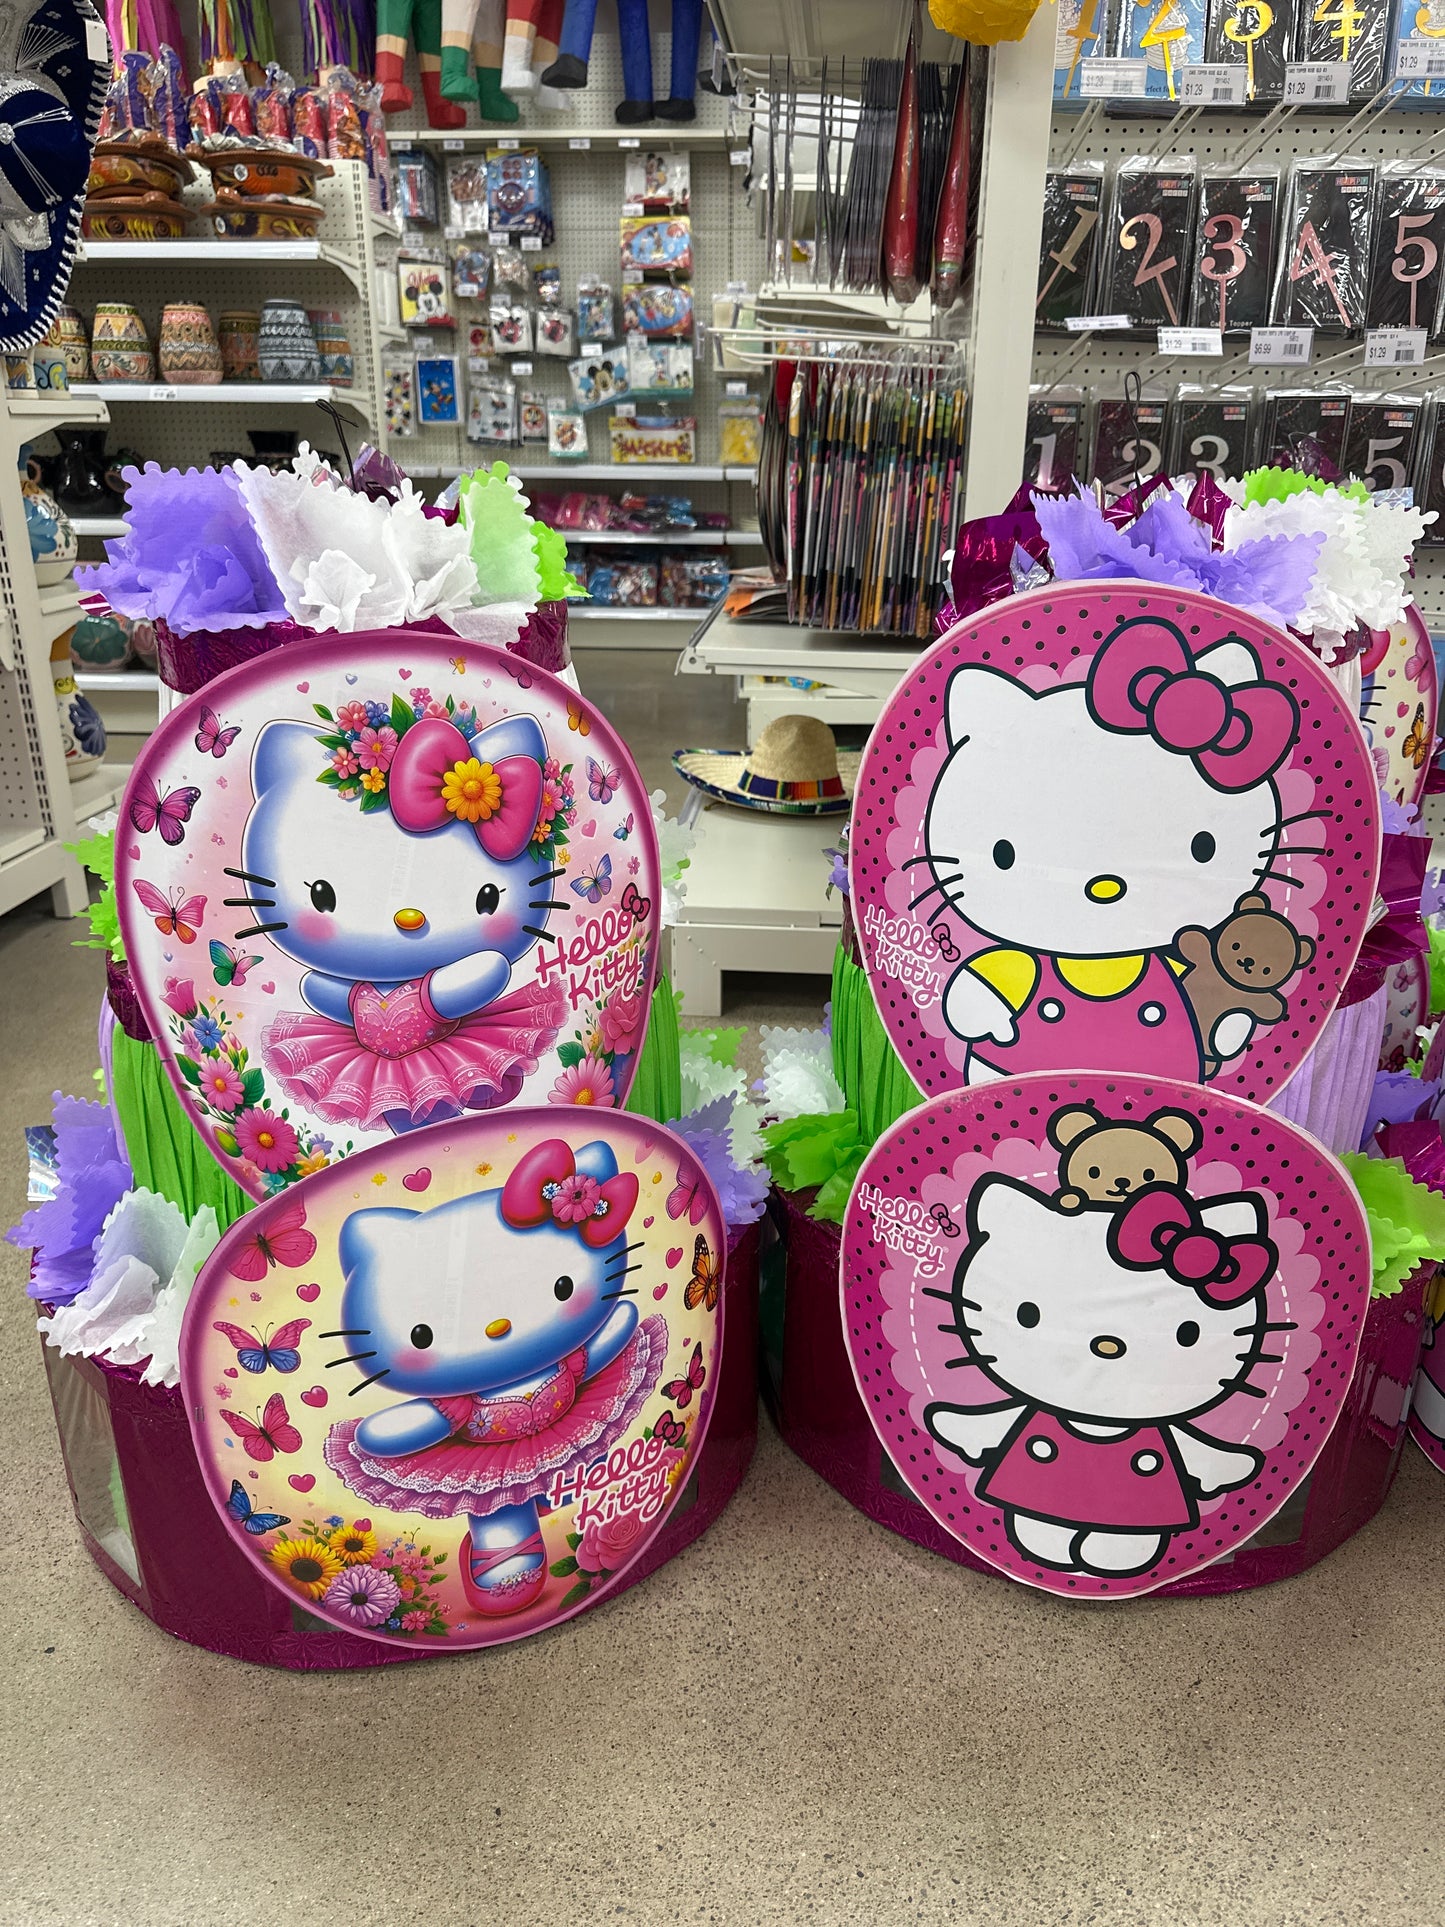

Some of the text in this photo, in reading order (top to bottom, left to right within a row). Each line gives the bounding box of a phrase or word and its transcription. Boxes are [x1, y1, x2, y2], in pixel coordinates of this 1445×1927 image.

[1185, 83, 1203, 95] $1.29
[1287, 82, 1306, 95] $1.29
[1400, 56, 1418, 68] $1.29
[1049, 205, 1099, 273] 1
[1119, 213, 1178, 288] 2
[1201, 213, 1247, 281] 3
[1291, 220, 1351, 286] 4
[1391, 212, 1438, 283] 5
[1254, 343, 1272, 355] $6.99
[1369, 346, 1386, 358] $1.29
[1032, 433, 1059, 492] 1
[1104, 439, 1162, 498] 2
[1186, 435, 1230, 482] 3
[1364, 436, 1406, 493] 5
[534, 909, 634, 985] Hello
[864, 904, 940, 963] Hello
[567, 945, 642, 1012] Kitty
[876, 940, 940, 1009] Kitty
[858, 1182, 940, 1238] Hello
[873, 1215, 945, 1279] Kitty
[549, 1437, 665, 1507] Hello
[576, 1467, 670, 1531] Kitty
